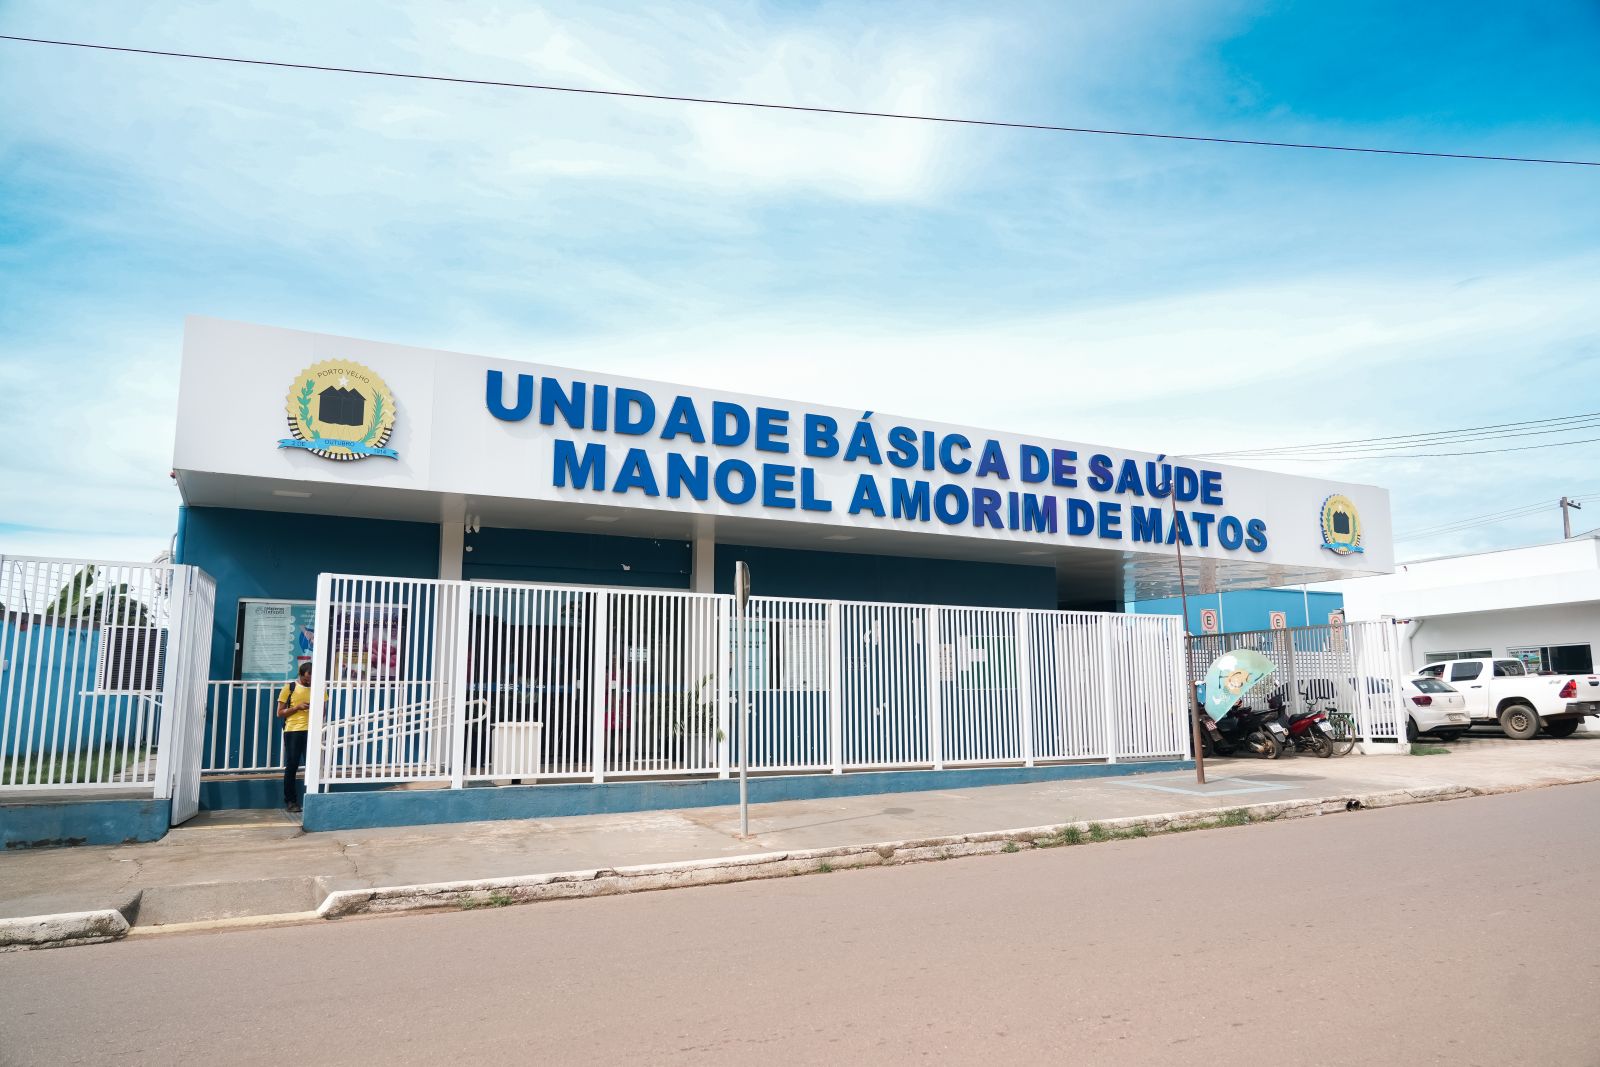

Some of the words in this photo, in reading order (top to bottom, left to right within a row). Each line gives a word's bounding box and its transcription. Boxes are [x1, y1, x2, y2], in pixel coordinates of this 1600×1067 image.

[317, 368, 344, 378] PORTO
[345, 369, 370, 384] VELHO
[486, 369, 790, 454] UNIDADE
[804, 411, 1010, 479] BÁSICA
[1020, 444, 1078, 488] DE
[1087, 454, 1223, 506] SAÚDE
[553, 439, 833, 512] MANOEL
[847, 474, 1058, 533] AMORIM
[1066, 498, 1123, 540] DE
[1130, 505, 1268, 553] MATOS
[1206, 615, 1212, 626] E
[1275, 618, 1281, 628] E
